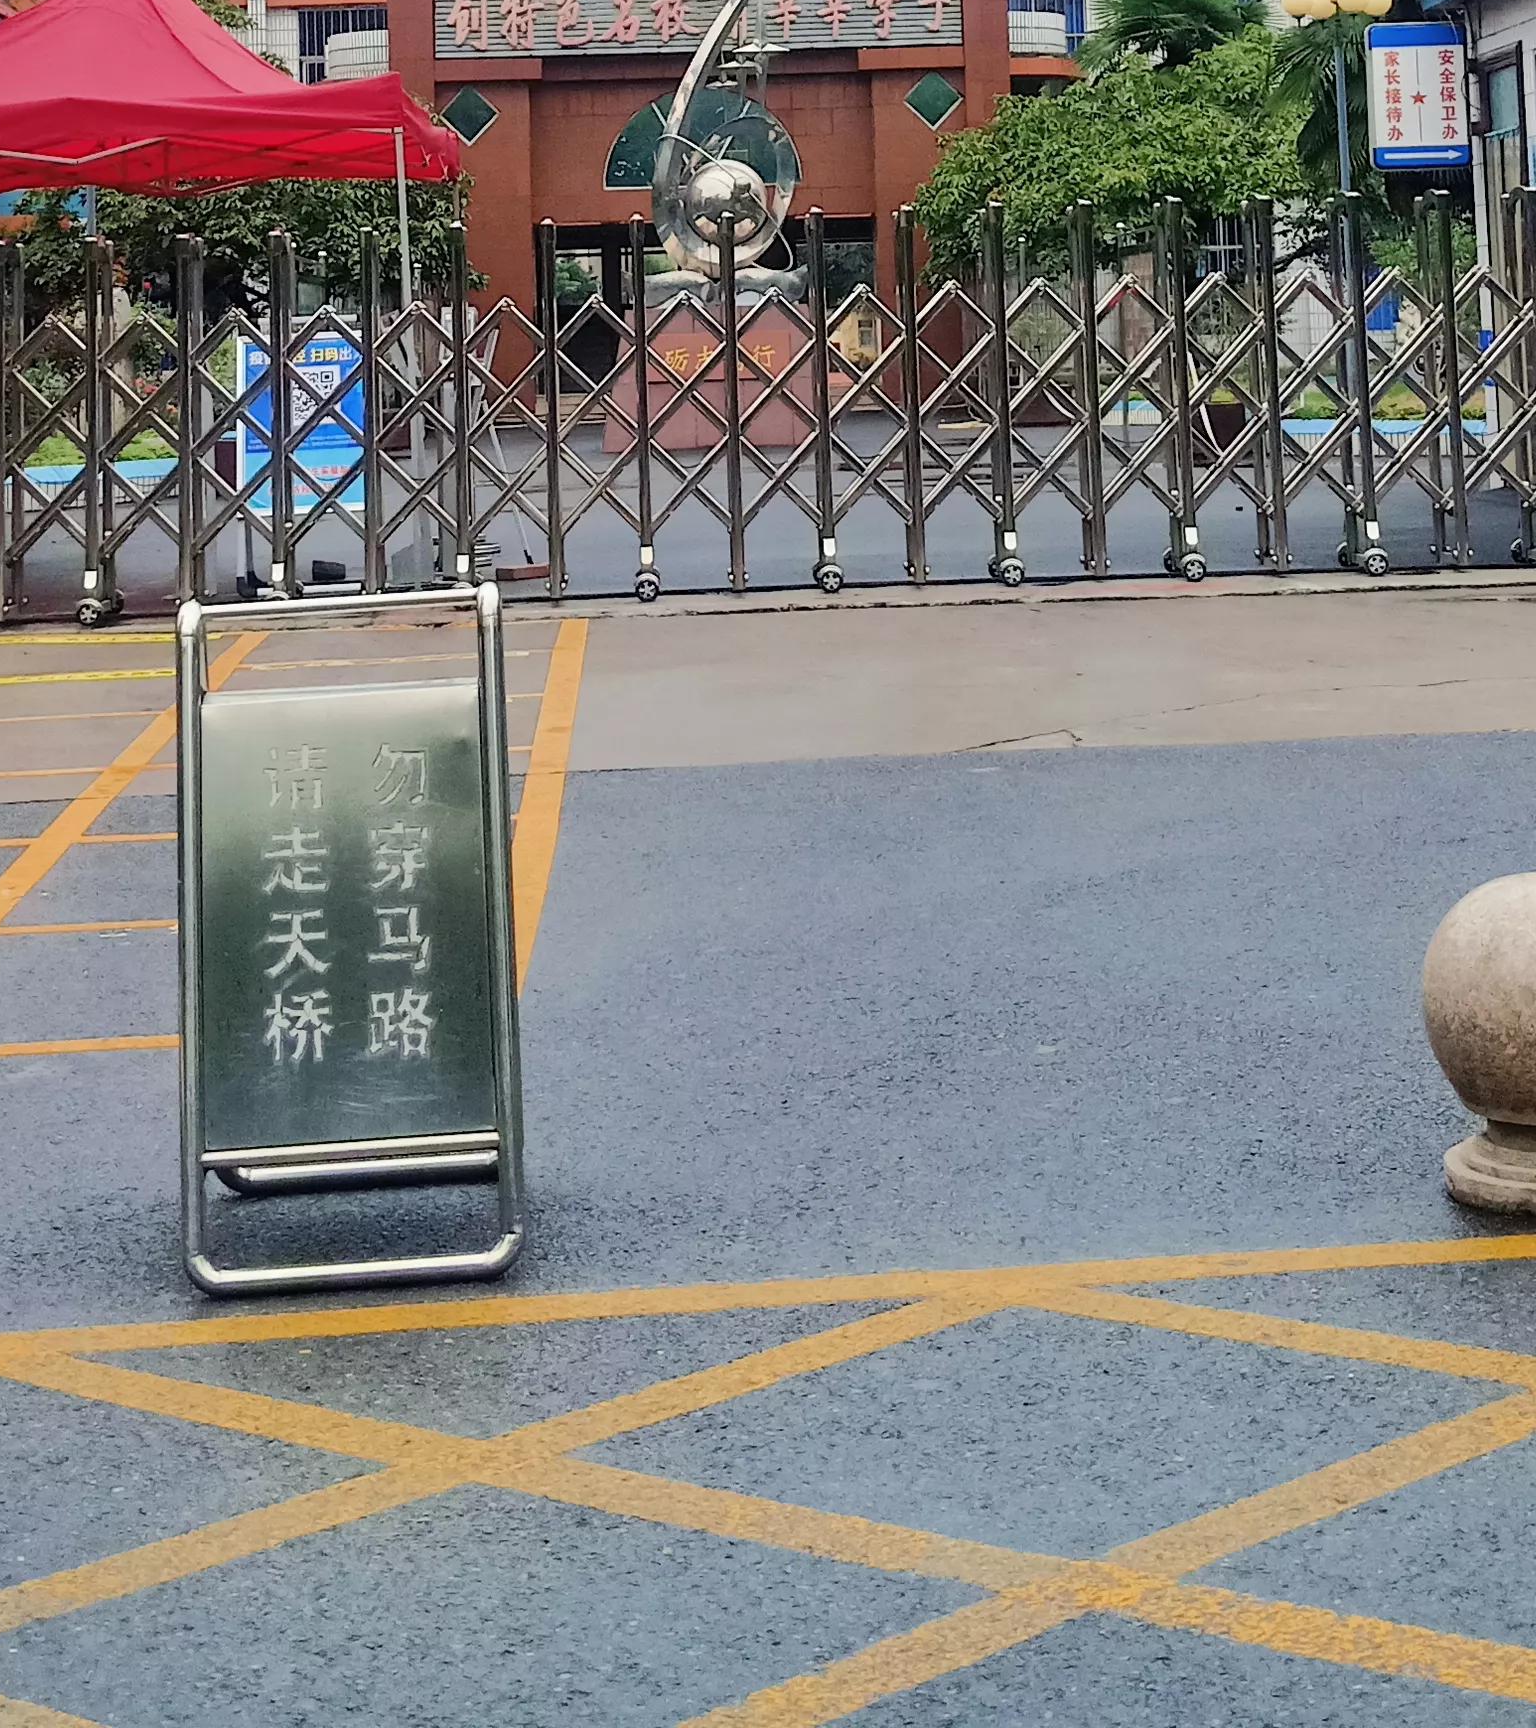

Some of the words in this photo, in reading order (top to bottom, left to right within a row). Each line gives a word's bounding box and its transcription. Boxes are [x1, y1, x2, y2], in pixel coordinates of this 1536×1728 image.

[1383, 50, 1404, 142] 家长接待办
[1438, 48, 1459, 140] 安全保卫办
[261, 742, 332, 1063] 请走天桥
[367, 741, 437, 1059] 勿穿马路
